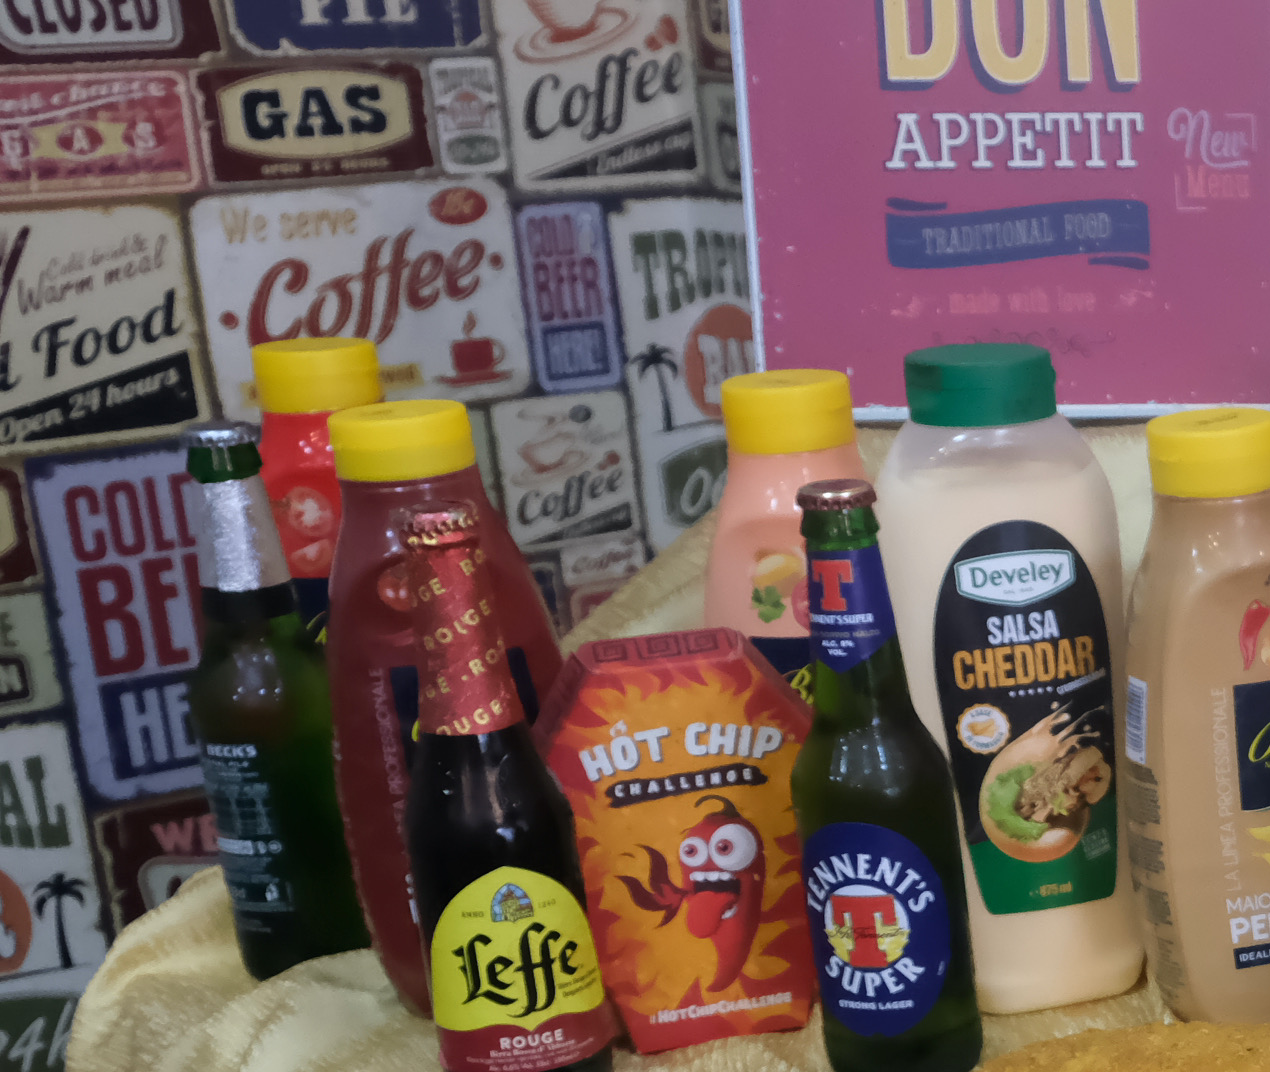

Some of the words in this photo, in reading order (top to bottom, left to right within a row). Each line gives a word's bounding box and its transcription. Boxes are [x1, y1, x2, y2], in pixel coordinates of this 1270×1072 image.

[240, 84, 389, 140] GAS
[523, 47, 684, 141] Coffee
[884, 112, 1145, 170] APPETIT
[1166, 106, 1250, 170] New
[219, 206, 268, 245] We
[279, 207, 358, 242] serve
[921, 216, 1054, 256] TRADITIONAL
[17, 274, 94, 316] Warm
[103, 233, 168, 286] meal
[246, 227, 487, 347] Coffee
[31, 287, 184, 378] Food
[516, 470, 623, 527] Coffee
[811, 559, 854, 612] T
[968, 560, 1064, 589] Develey
[986, 609, 1061, 646] SALSA
[952, 634, 1097, 691] CHEDDAR
[684, 721, 784, 759] CHIP
[1210, 687, 1235, 818] PROFESSIONALE
[613, 767, 754, 799] CHALLENGE
[806, 852, 936, 914] TENNENT'S
[829, 894, 897, 969] T
[451, 921, 579, 1019] Leffe
[824, 954, 926, 998] SUPER
[838, 998, 877, 1012] STRONG
[878, 998, 915, 1011] LAGER
[499, 1028, 564, 1051] ROUGE
